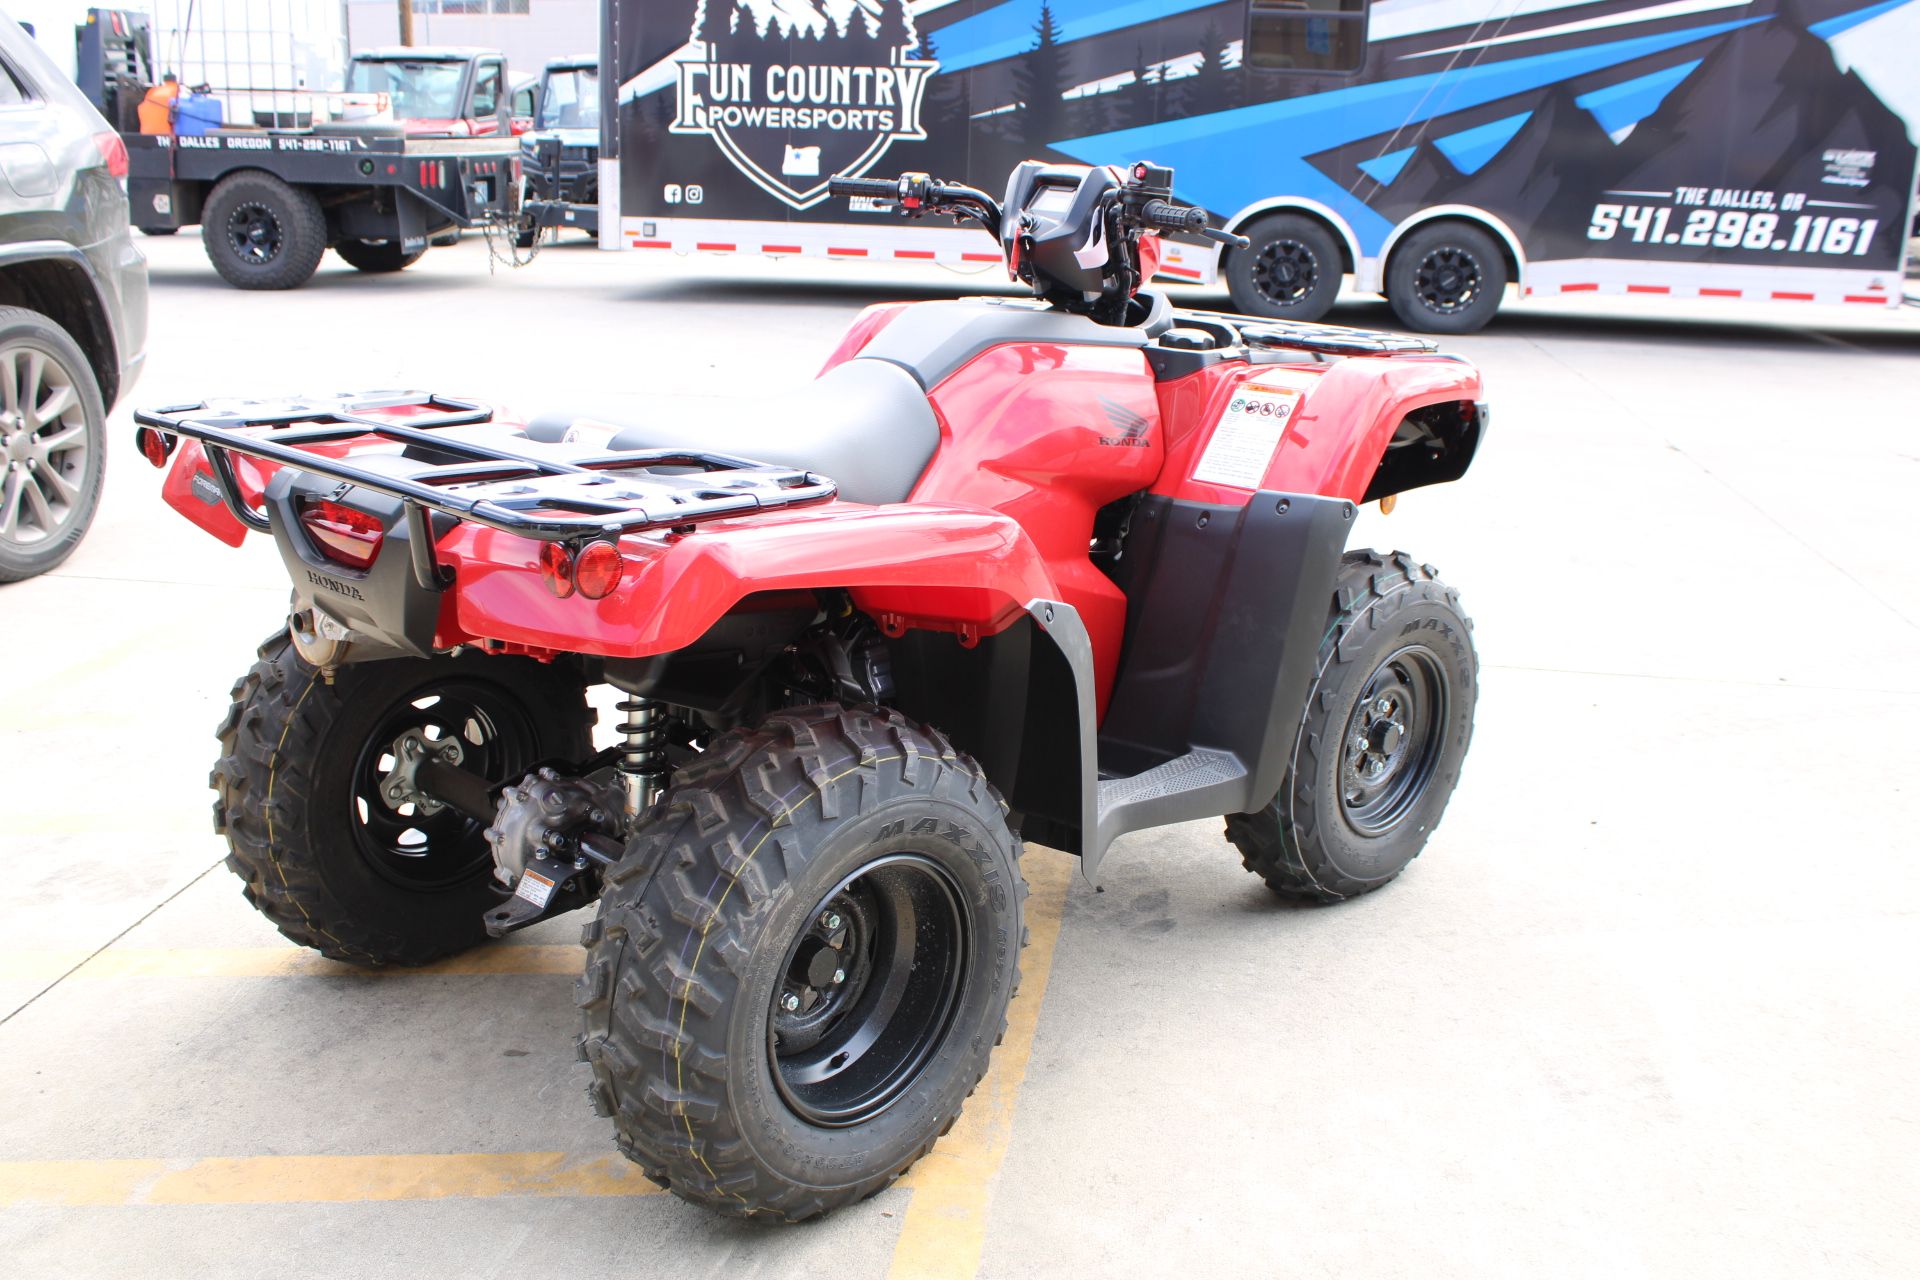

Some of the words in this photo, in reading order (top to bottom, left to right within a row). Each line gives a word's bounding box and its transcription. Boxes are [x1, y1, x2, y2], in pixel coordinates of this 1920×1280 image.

[681, 62, 752, 126] FUN
[766, 64, 923, 133] COUNTRY
[708, 106, 894, 131] POWERSPORTS
[156, 135, 171, 148] TH
[179, 136, 220, 150] DALLES
[226, 137, 272, 150] OREGON
[1674, 187, 1708, 206] THE
[1708, 189, 1776, 211] DALLES,
[1780, 193, 1807, 211] OR
[1586, 204, 1879, 256] 541.298.1161
[1098, 436, 1151, 447] HONDA
[306, 570, 366, 601] HONDA
[1399, 618, 1471, 688] MAXXIS
[870, 816, 1007, 914] MAXXIS
